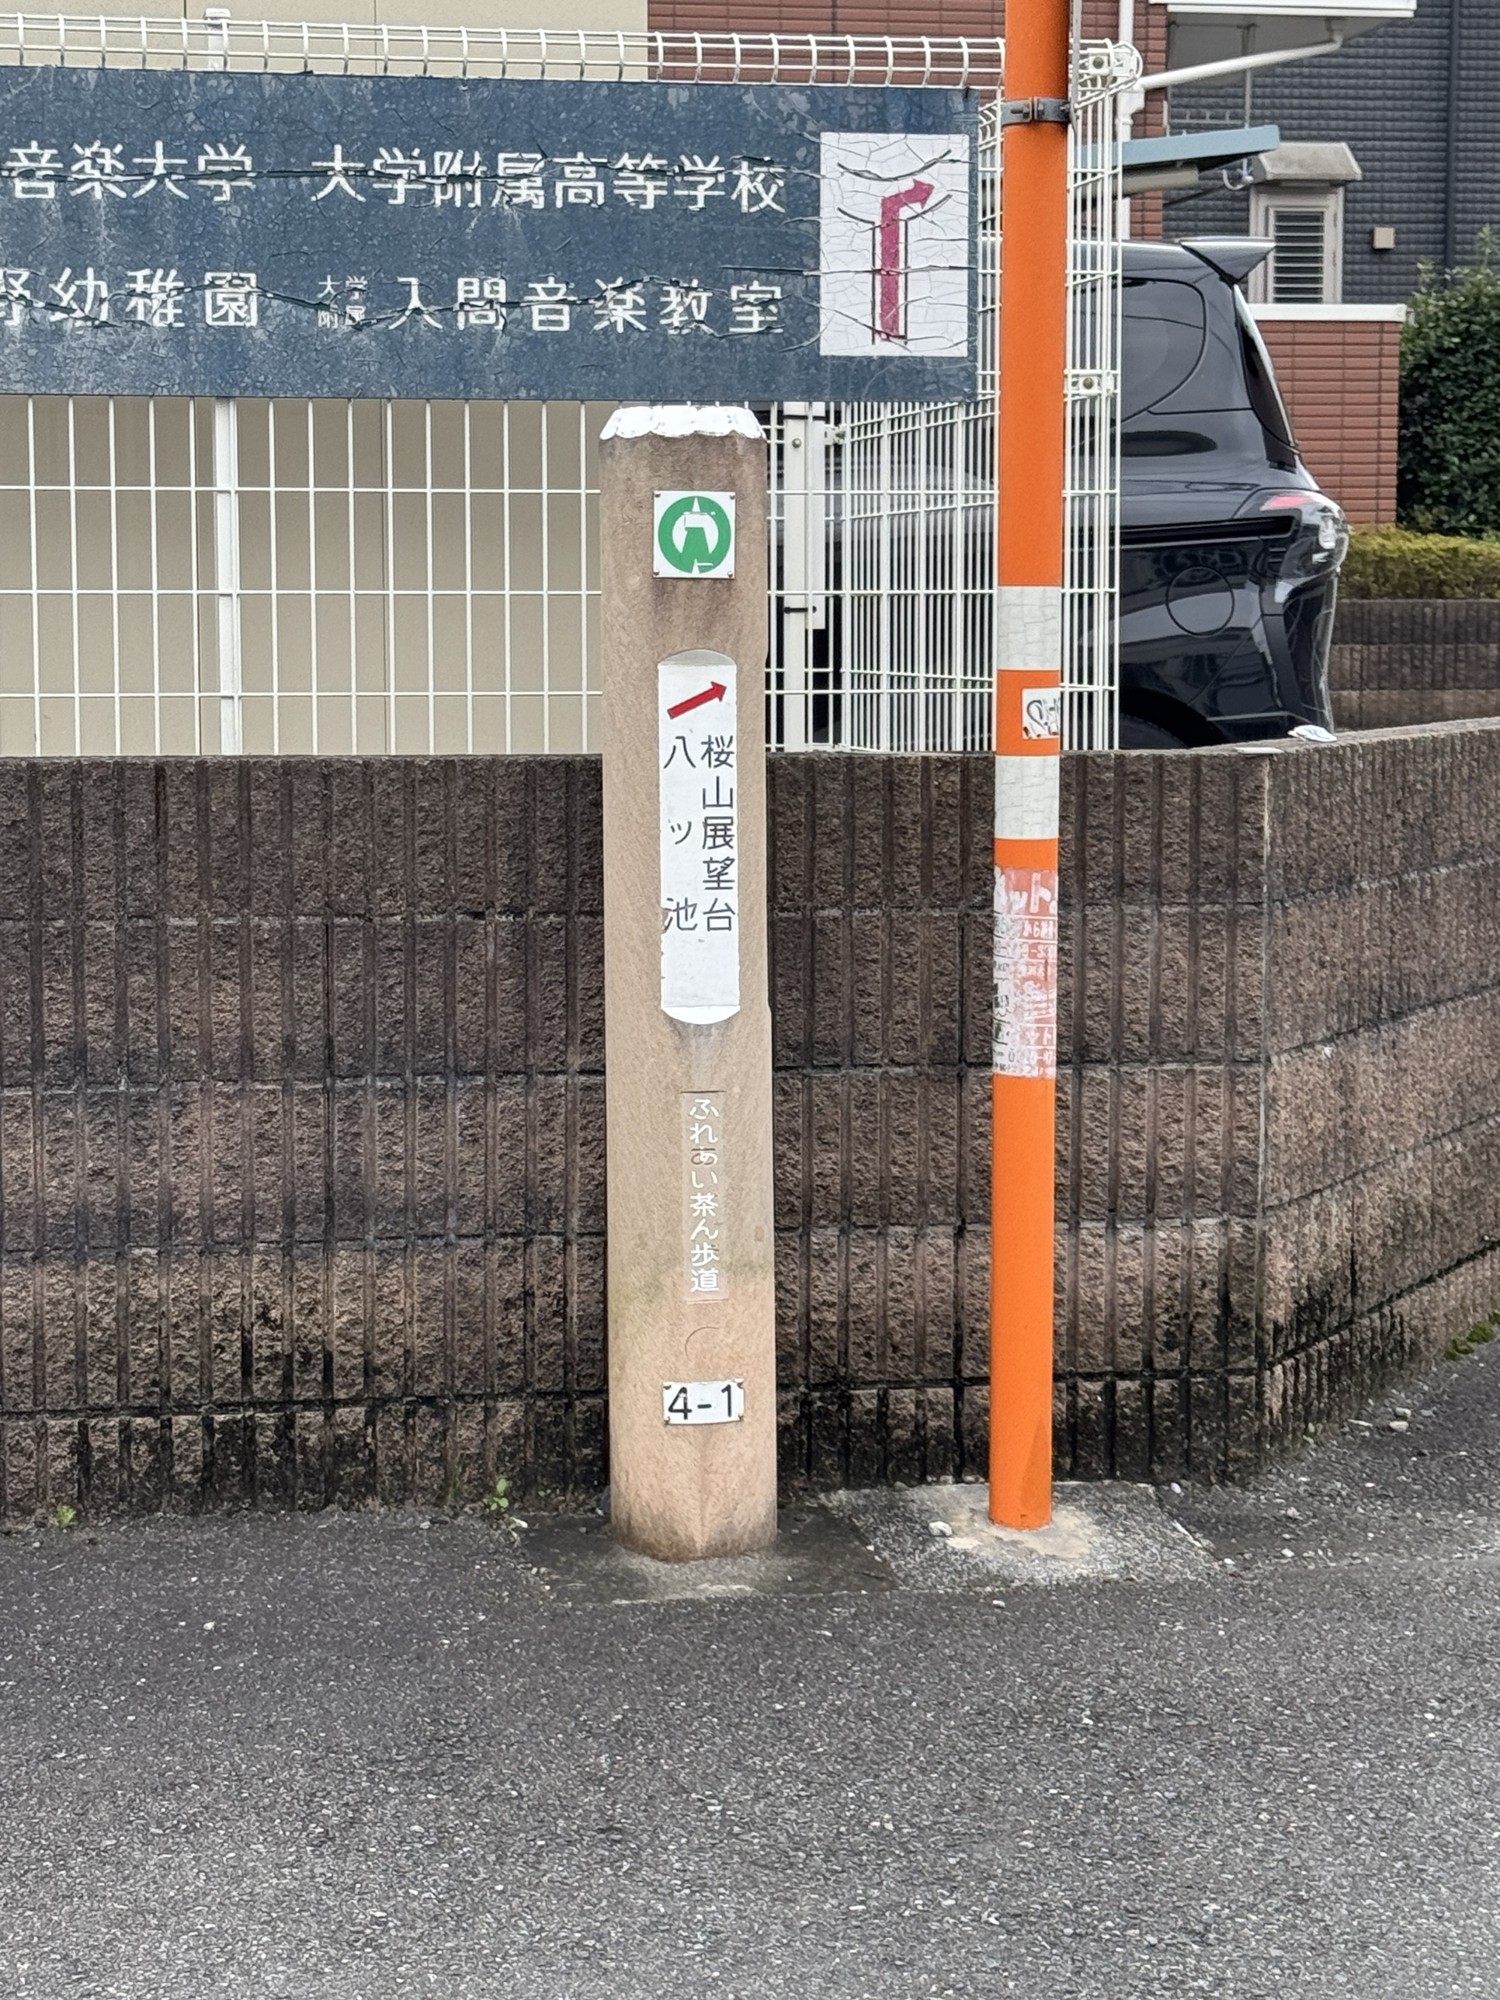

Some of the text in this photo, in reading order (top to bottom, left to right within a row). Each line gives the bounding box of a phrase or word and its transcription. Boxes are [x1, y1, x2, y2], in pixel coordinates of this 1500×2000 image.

[5, 140, 257, 201] 音楽大学
[311, 144, 786, 214] 大学附属高等学校
[387, 274, 784, 335] 入間音楽教室
[700, 734, 736, 933] 桜山展望台
[689, 1098, 720, 1293] ふれあい茶ん歩道
[667, 1383, 733, 1421] 4-1
